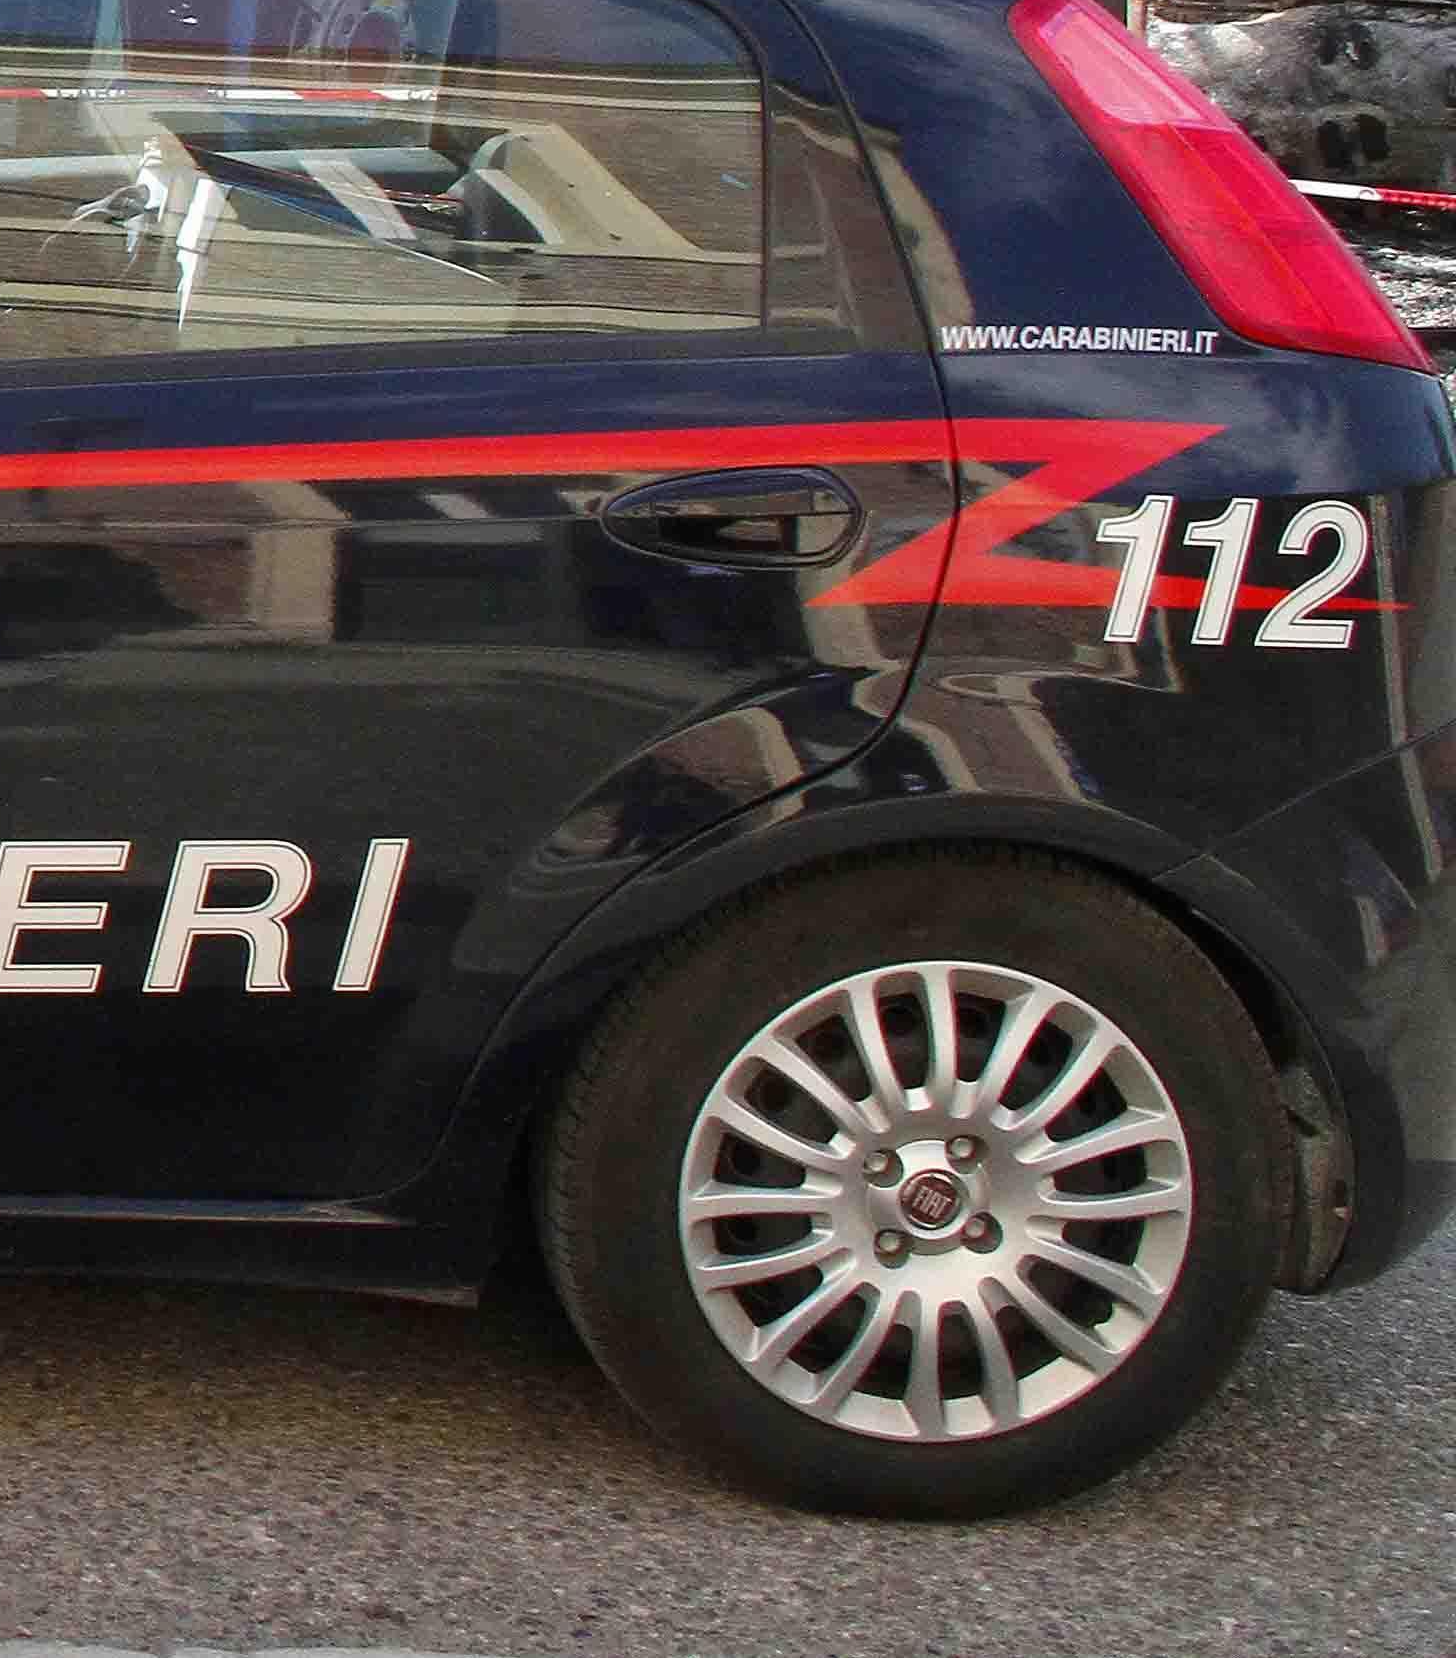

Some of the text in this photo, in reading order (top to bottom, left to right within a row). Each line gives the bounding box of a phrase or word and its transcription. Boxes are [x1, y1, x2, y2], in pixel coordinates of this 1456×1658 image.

[940, 325, 1220, 355] WWW.CARABINIERI.IT
[1096, 494, 1370, 649] 112
[911, 1184, 953, 1220] FIAT
